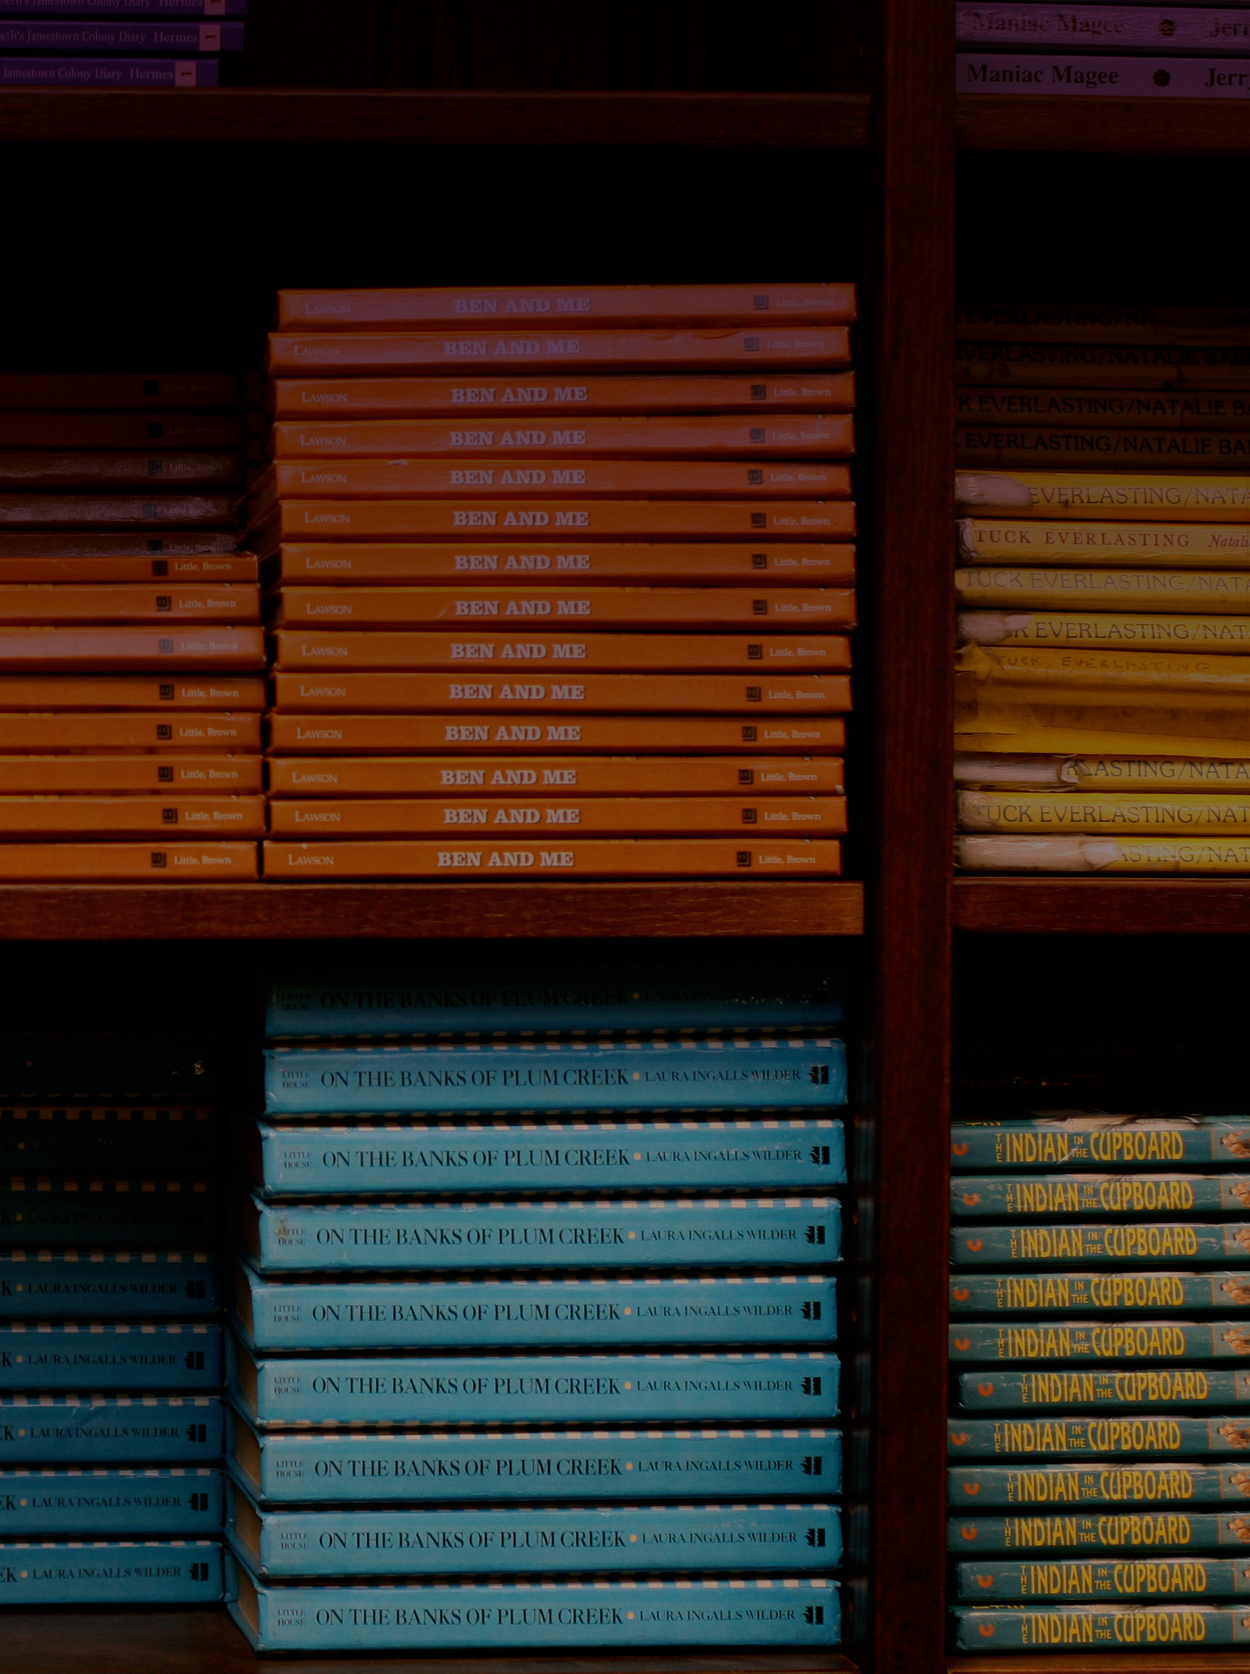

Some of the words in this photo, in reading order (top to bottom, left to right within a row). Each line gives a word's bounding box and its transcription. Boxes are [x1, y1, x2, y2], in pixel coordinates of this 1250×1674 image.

[972, 12, 1049, 33] Maniac
[1056, 14, 1125, 38] Magee
[1209, 17, 1250, 38] Jerr
[25, 30, 80, 43] Jamestown
[82, 30, 116, 45] Colony
[119, 31, 147, 45] Diary
[153, 31, 198, 43] Hermes
[2, 67, 56, 80] Jamestown
[58, 67, 92, 81] Colony
[95, 67, 123, 81] Diary
[129, 68, 174, 80] Hermes
[967, 64, 1044, 84] Maniac
[1051, 65, 1119, 89] Magee
[1205, 68, 1250, 88] Jerr
[976, 529, 1032, 545] TUCK
[1044, 531, 1190, 548] EVERLASTING
[1207, 534, 1250, 549] Natali
[174, 562, 201, 573] Little,
[202, 562, 232, 572] Brown
[178, 598, 205, 609] Little,
[206, 598, 237, 609] Brown
[1062, 656, 1211, 673] EVERLASTING
[437, 850, 483, 868] BEN
[488, 850, 537, 868] AND
[540, 850, 574, 867] ME
[758, 853, 785, 865] Little,
[786, 853, 816, 865] Brown
[321, 1071, 349, 1088] ON
[353, 1070, 395, 1088] THE
[400, 1070, 466, 1087] BANKS
[471, 1070, 499, 1087] OF
[503, 1069, 559, 1087] PLUM
[563, 1068, 629, 1086] CREEK
[644, 1070, 689, 1082] LAURA
[692, 1070, 749, 1082] INGALLS
[751, 1070, 801, 1081] WILDER
[1005, 1132, 1070, 1163] INDIAN
[1073, 1135, 1085, 1146] IN
[1090, 1130, 1186, 1161] CUPBOARD
[1071, 1147, 1089, 1159] THE
[32, 1568, 75, 1581] LAURA
[78, 1567, 132, 1580] INGALLS
[134, 1566, 182, 1578] WILDER
[1031, 1614, 1095, 1644] INDIAN
[1097, 1616, 1109, 1627] IN
[1113, 1611, 1207, 1643] CUPBOARD
[1094, 1629, 1113, 1640] THE
